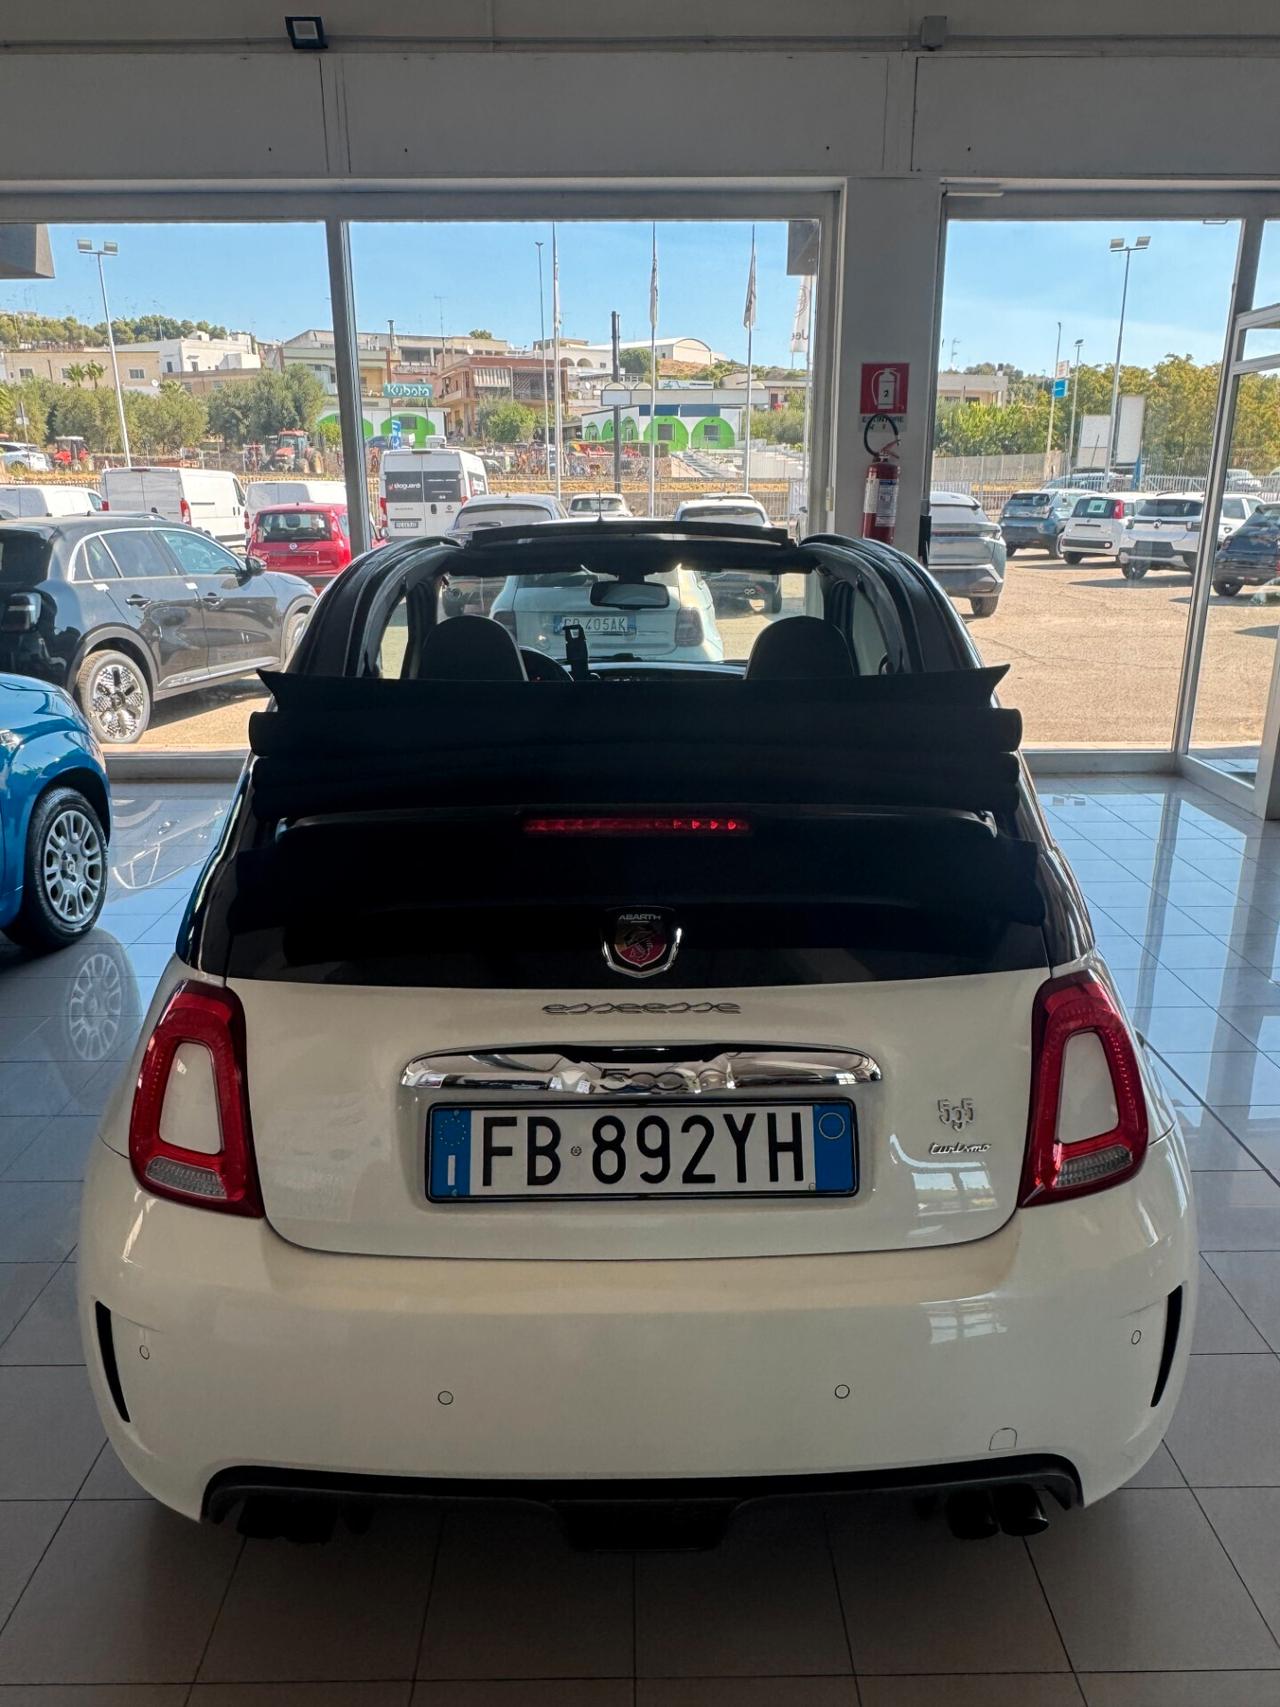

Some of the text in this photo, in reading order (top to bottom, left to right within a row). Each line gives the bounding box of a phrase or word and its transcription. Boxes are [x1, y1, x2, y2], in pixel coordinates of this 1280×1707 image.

[386, 384, 430, 397] Kubota
[618, 913, 661, 921] ABARTH
[937, 1097, 975, 1132] 595
[482, 1112, 805, 1186] FB 892YH
[928, 1142, 992, 1155] turismo
